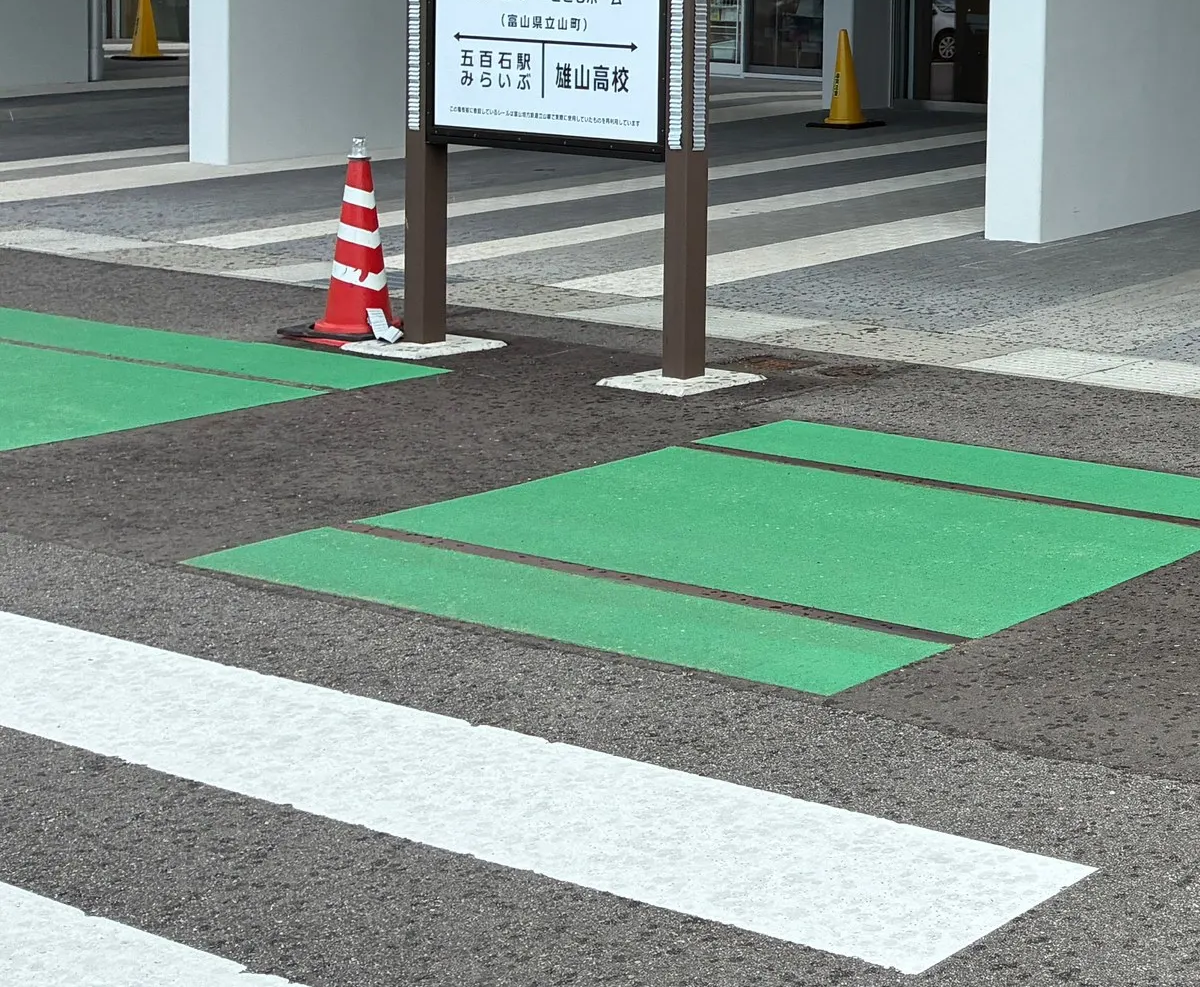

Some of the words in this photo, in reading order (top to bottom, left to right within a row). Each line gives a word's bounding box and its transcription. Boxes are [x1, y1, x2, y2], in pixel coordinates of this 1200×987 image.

[460, 49, 531, 71] 五百石駅
[460, 71, 531, 91] みらいぶ
[556, 62, 629, 93] 雄山高校
